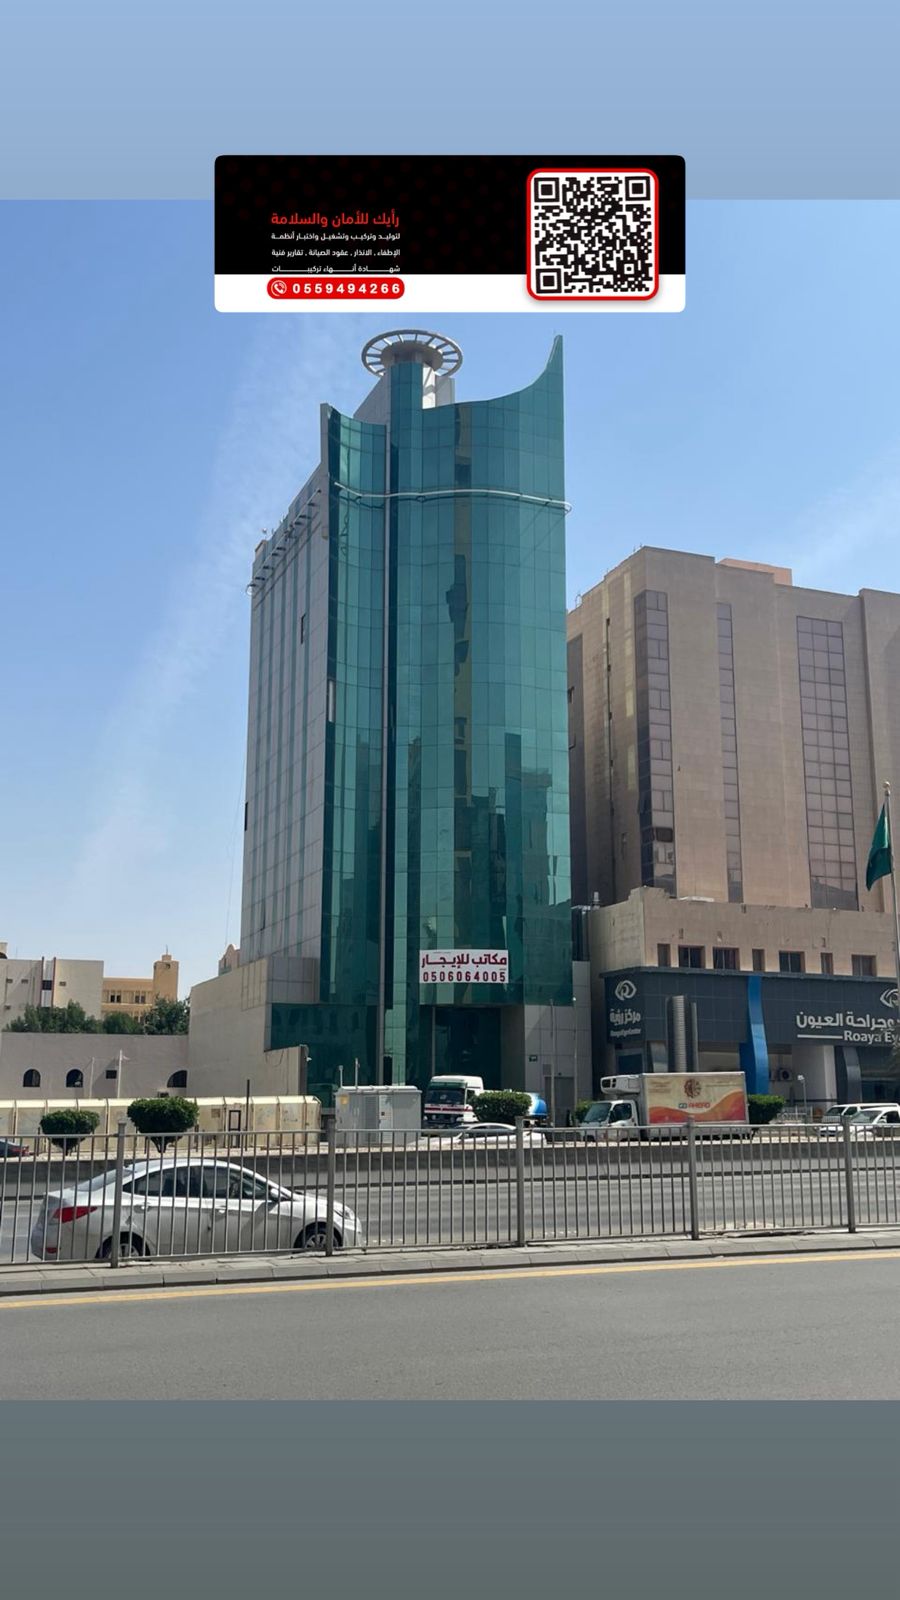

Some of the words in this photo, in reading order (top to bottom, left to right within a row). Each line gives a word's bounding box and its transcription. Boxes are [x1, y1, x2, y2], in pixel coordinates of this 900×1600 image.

[421, 953, 470, 969] للإيجار
[471, 953, 507, 968] مكاتب
[423, 971, 506, 982] 0506064005
[796, 1011, 843, 1029] العيون
[843, 1030, 882, 1044] Roaya
